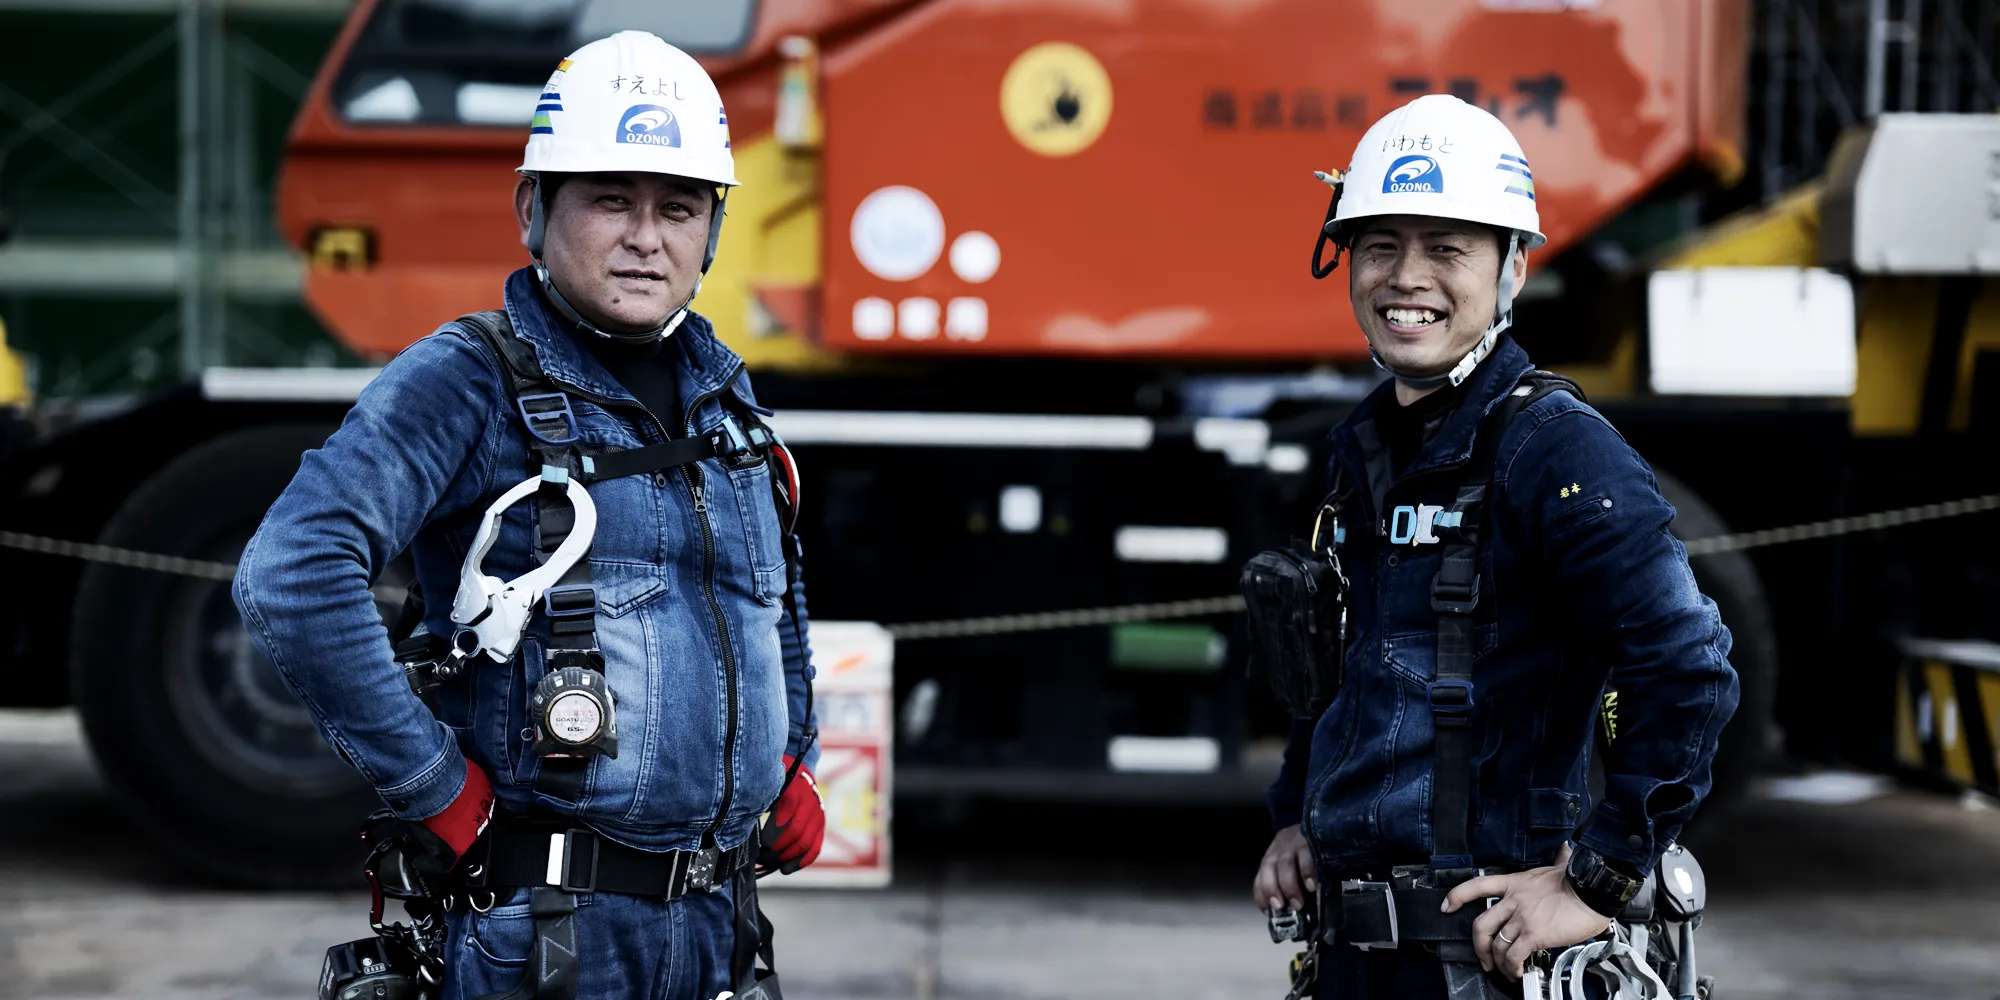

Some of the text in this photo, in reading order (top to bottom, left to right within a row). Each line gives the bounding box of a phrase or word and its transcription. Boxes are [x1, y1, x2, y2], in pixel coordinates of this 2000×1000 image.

[610, 74, 685, 101] すえよし
[626, 132, 670, 146] OZONO
[1382, 134, 1454, 154] いわもと
[1390, 182, 1432, 193] OZONO
